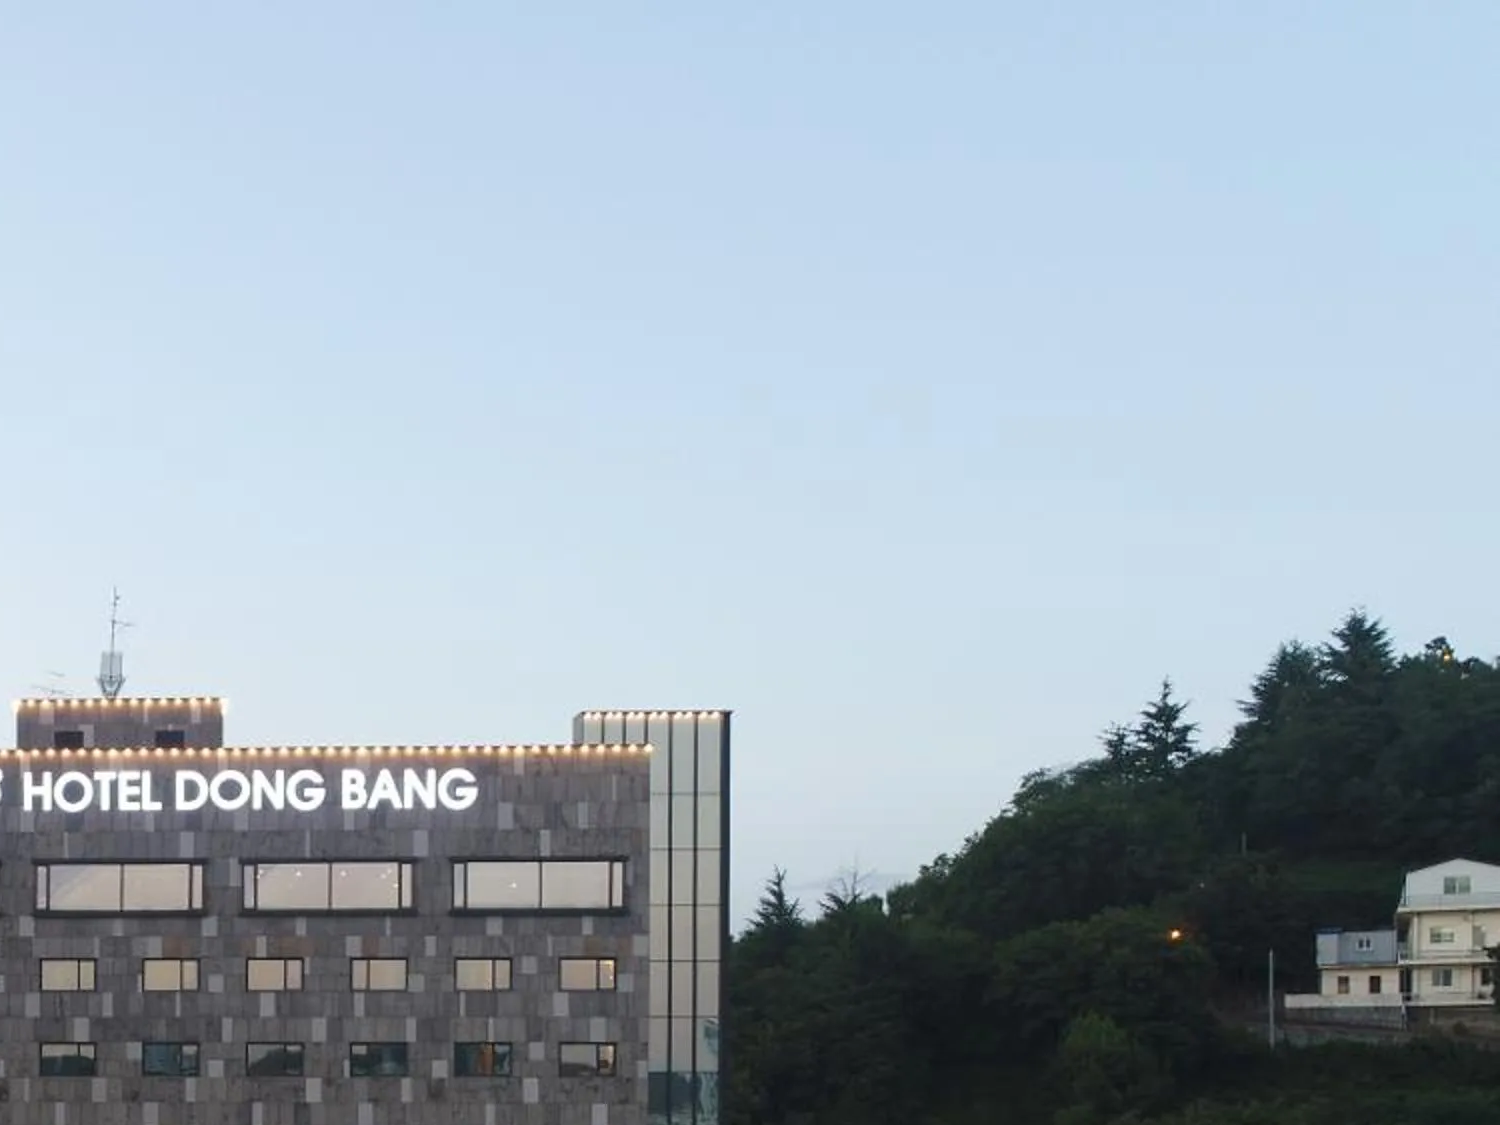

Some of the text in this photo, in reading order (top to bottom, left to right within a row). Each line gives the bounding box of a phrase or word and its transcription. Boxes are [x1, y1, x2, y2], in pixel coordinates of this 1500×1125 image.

[23, 769, 163, 813] HOTEL
[175, 768, 326, 812] DONG
[341, 768, 479, 811] BANG
